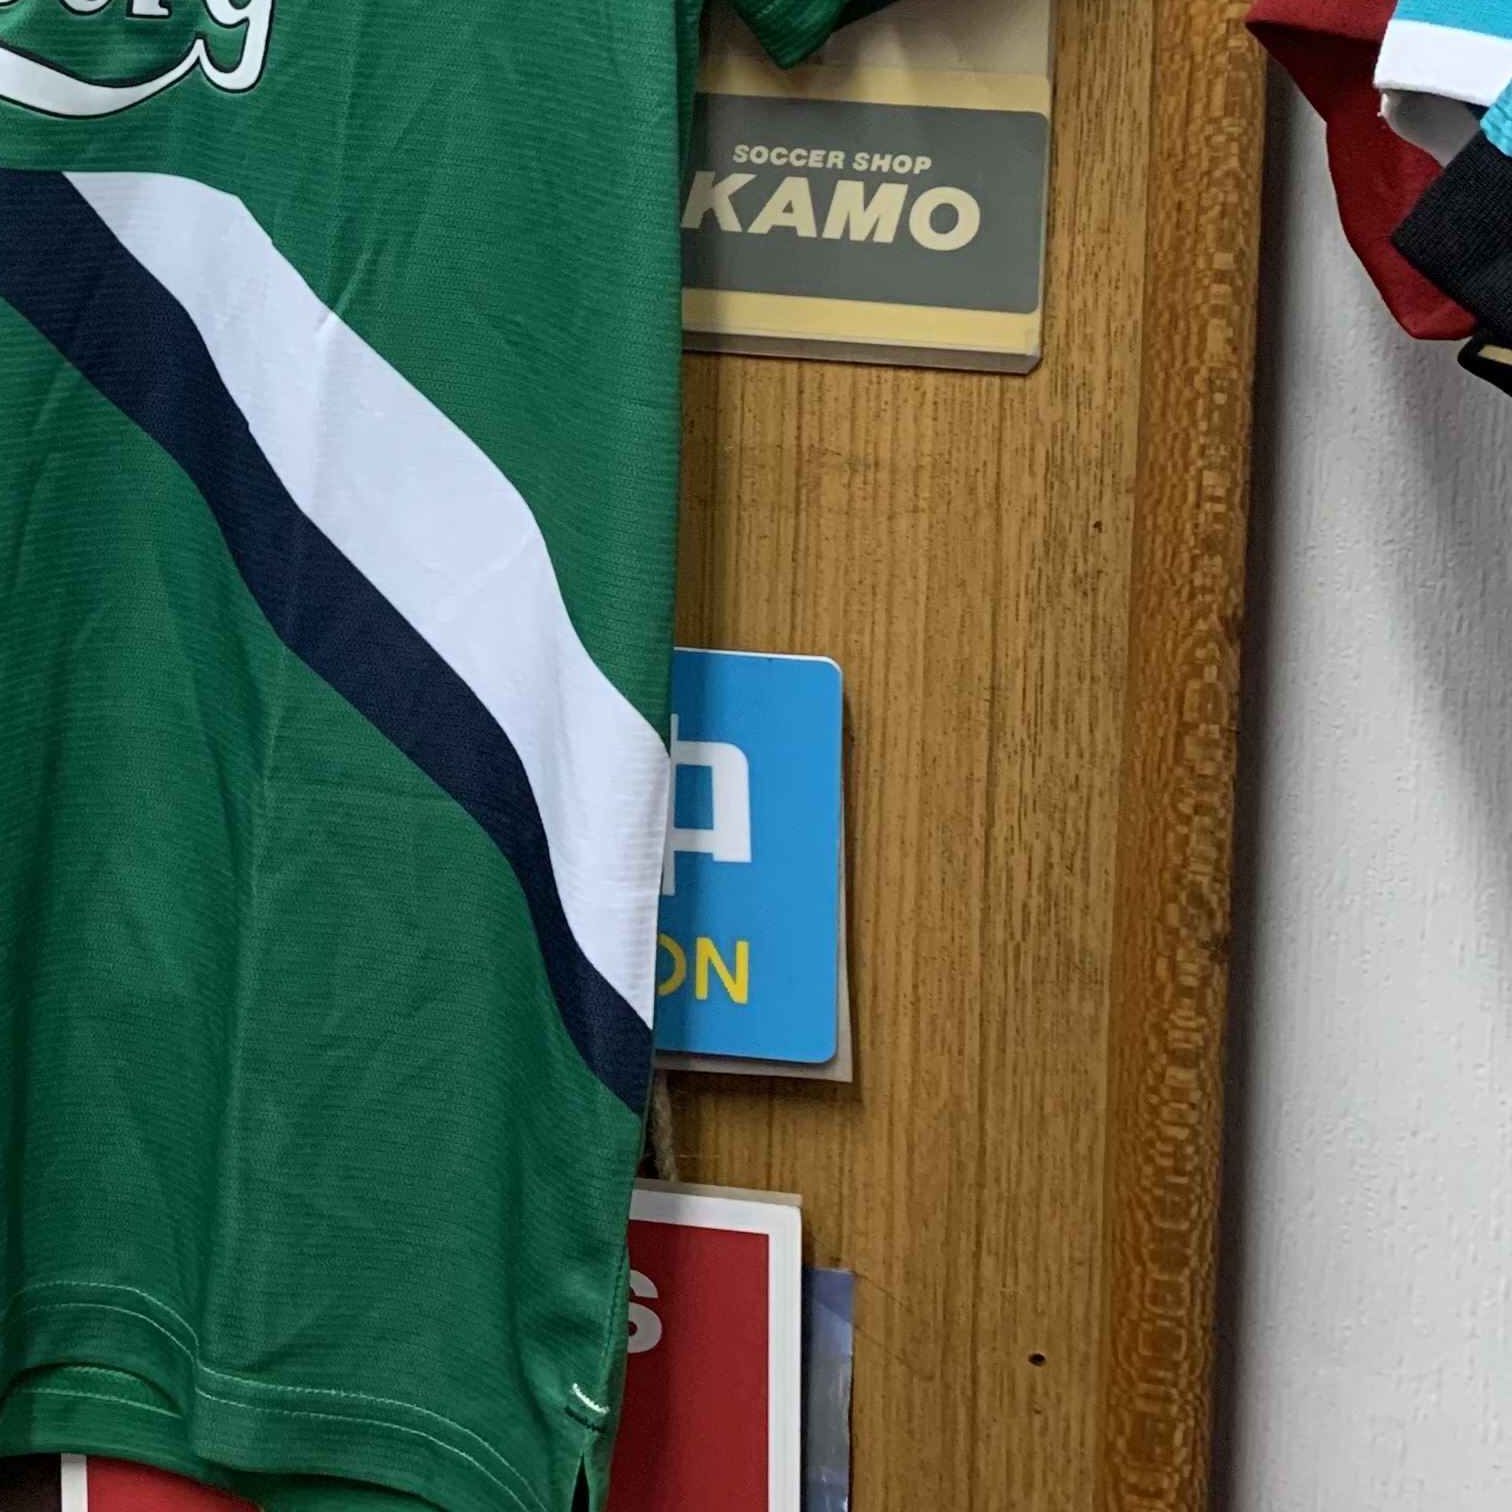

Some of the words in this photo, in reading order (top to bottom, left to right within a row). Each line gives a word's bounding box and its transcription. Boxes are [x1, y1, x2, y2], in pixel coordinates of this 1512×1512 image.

[732, 143, 846, 170] SOCCER
[851, 151, 933, 176] SHOP
[680, 170, 981, 252] KAMO
